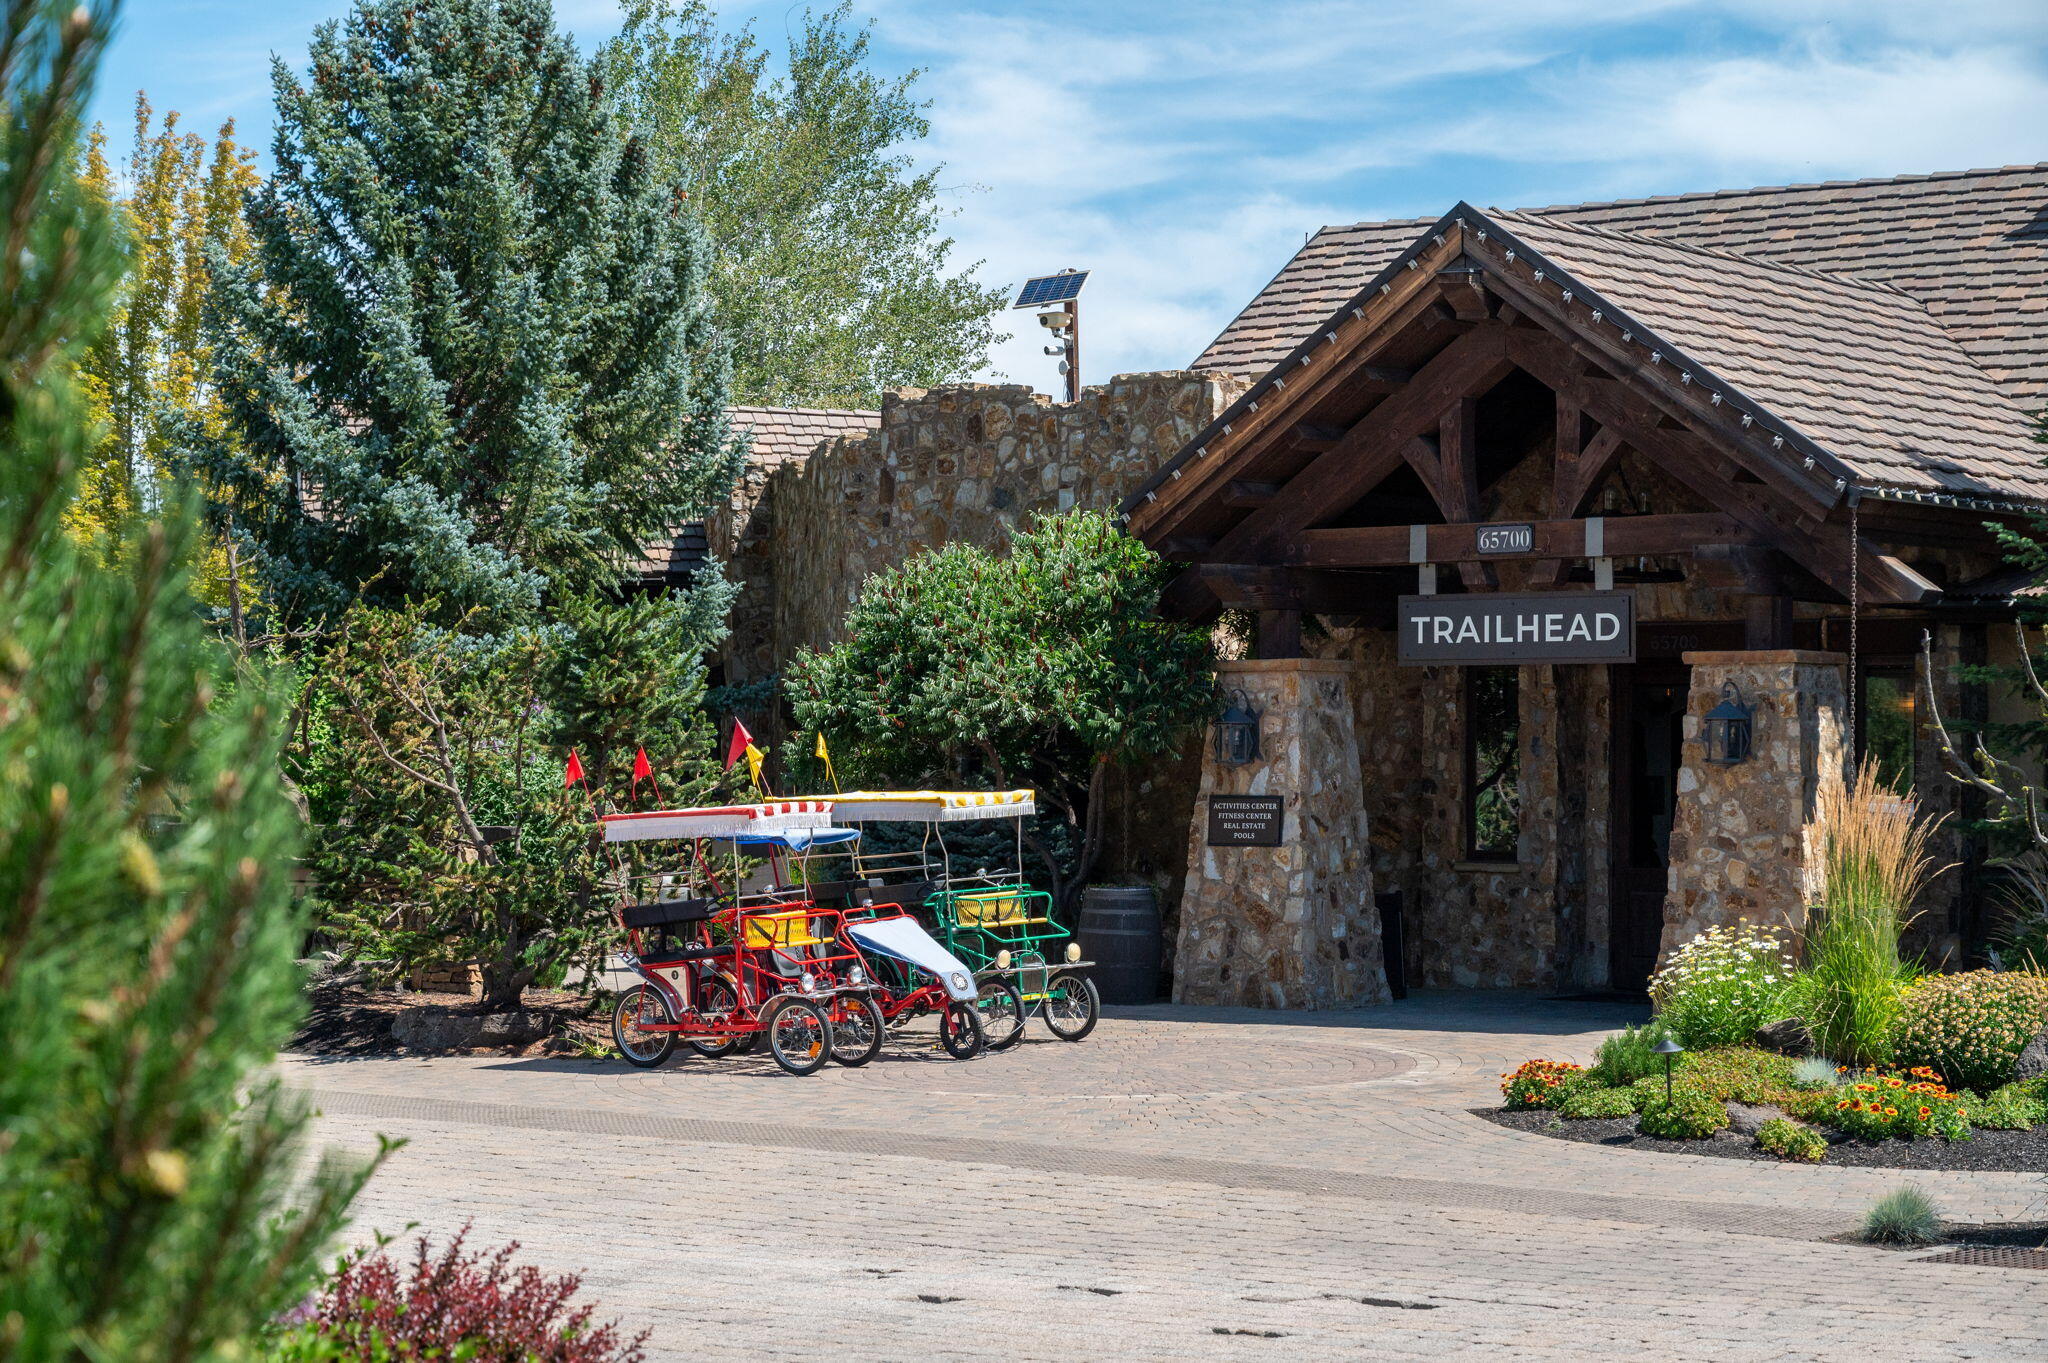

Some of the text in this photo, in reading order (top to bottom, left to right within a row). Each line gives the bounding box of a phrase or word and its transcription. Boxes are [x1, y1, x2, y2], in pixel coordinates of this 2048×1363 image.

[1480, 530, 1530, 549] 65700
[1410, 612, 1621, 644] TRAILHEAD
[1218, 812, 1272, 820] FITNESS CENTER
[1241, 822, 1266, 830] ESTATE
